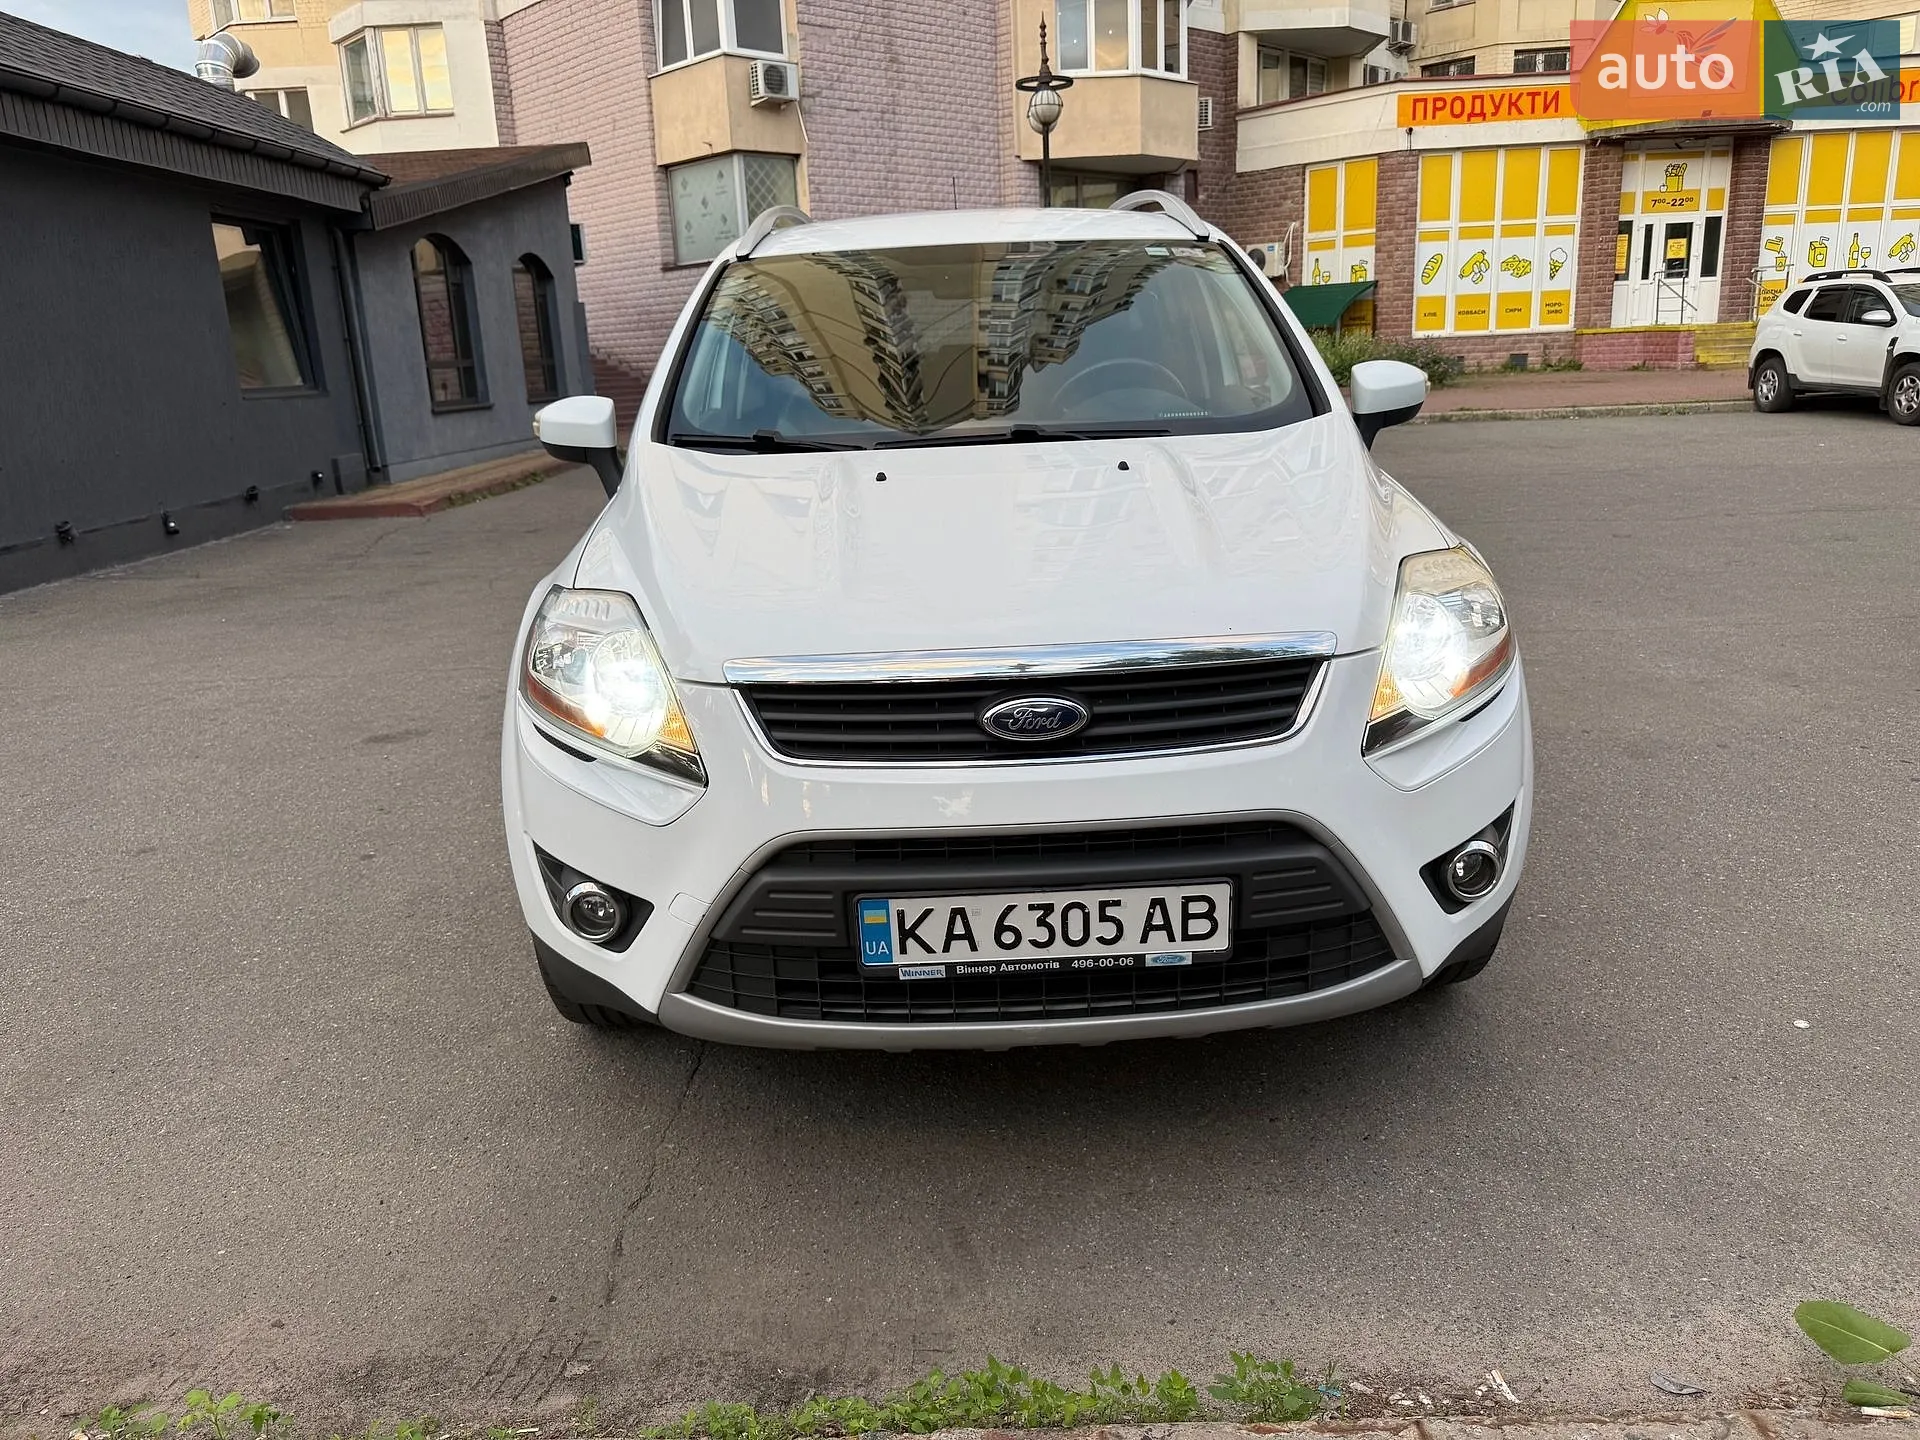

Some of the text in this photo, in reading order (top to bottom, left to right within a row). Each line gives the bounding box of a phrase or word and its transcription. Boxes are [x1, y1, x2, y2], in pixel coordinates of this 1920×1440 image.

[1411, 90, 1560, 122] ПРОДУКТИ
[1000, 707, 1062, 730] Ford
[896, 894, 1220, 955] KA 6305 AB
[865, 941, 890, 955] UA
[900, 968, 945, 978] WINNER
[956, 957, 1134, 974] Віннер Автомотів 496-00-06
